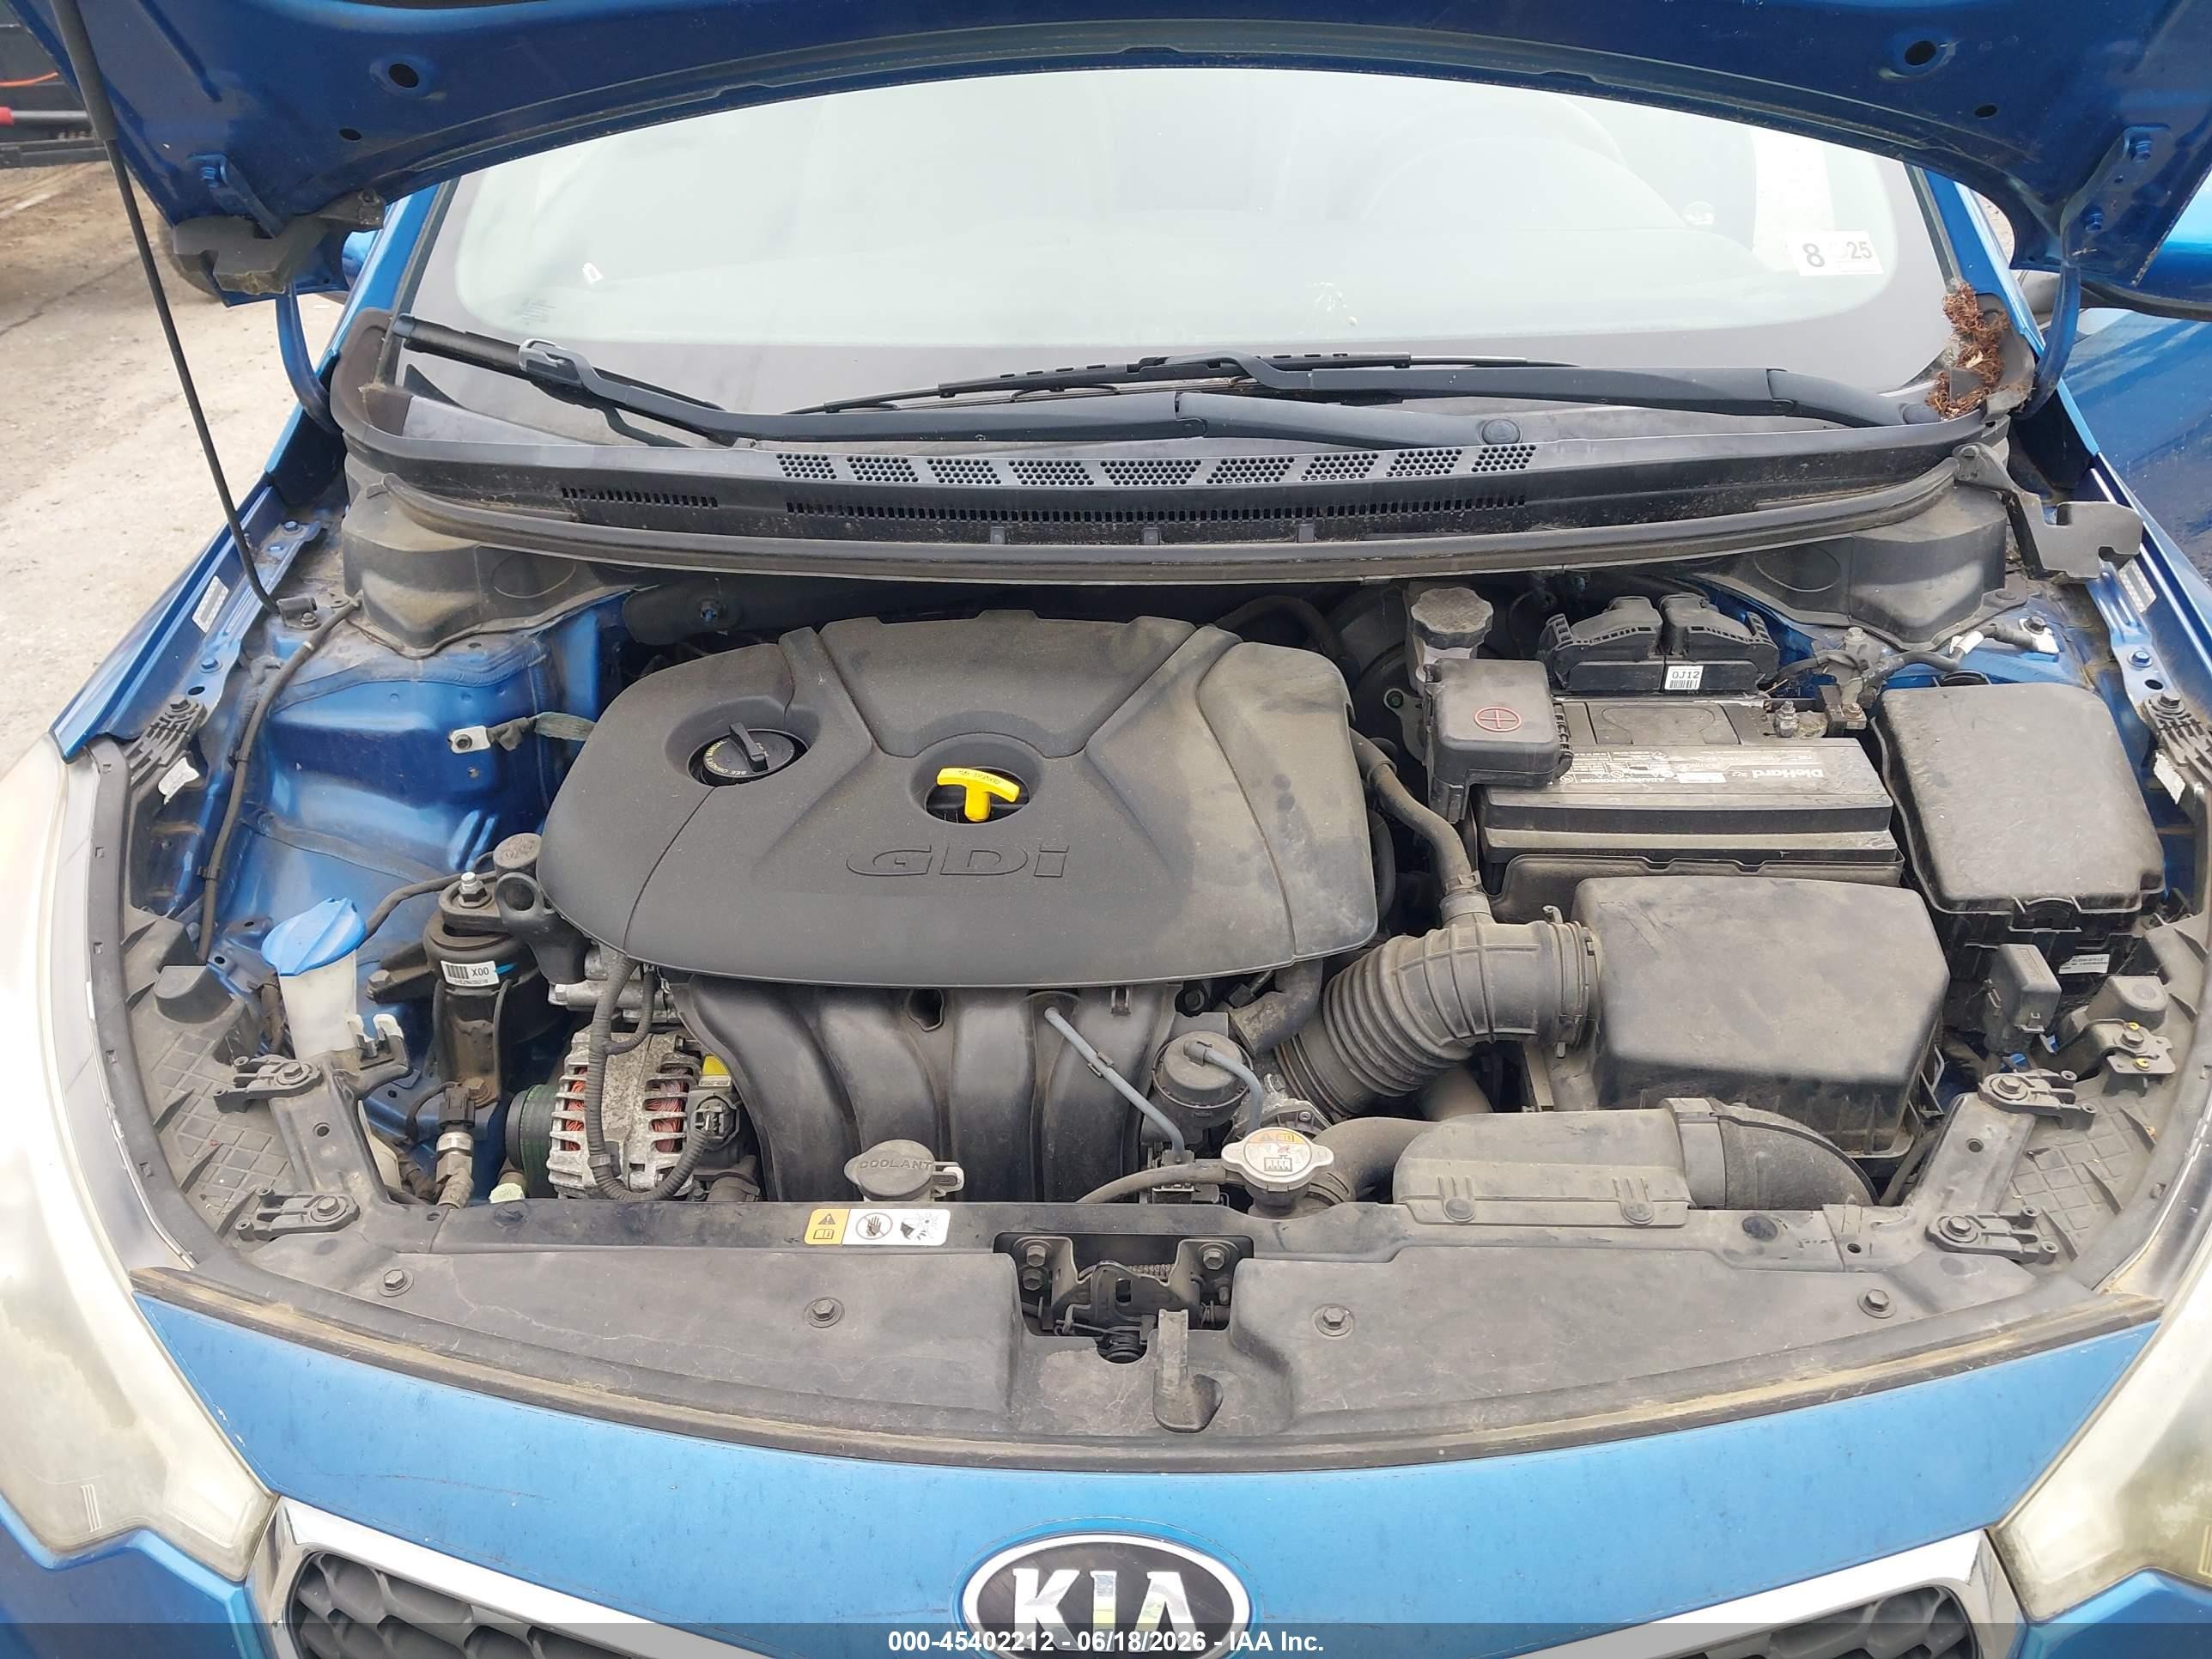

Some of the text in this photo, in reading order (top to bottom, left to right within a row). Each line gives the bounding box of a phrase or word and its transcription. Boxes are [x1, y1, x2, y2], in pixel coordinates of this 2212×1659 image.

[1802, 241, 1873, 268] 8 25
[1752, 769, 1824, 779] DieHard
[1012, 1568, 1205, 1653] KIA
